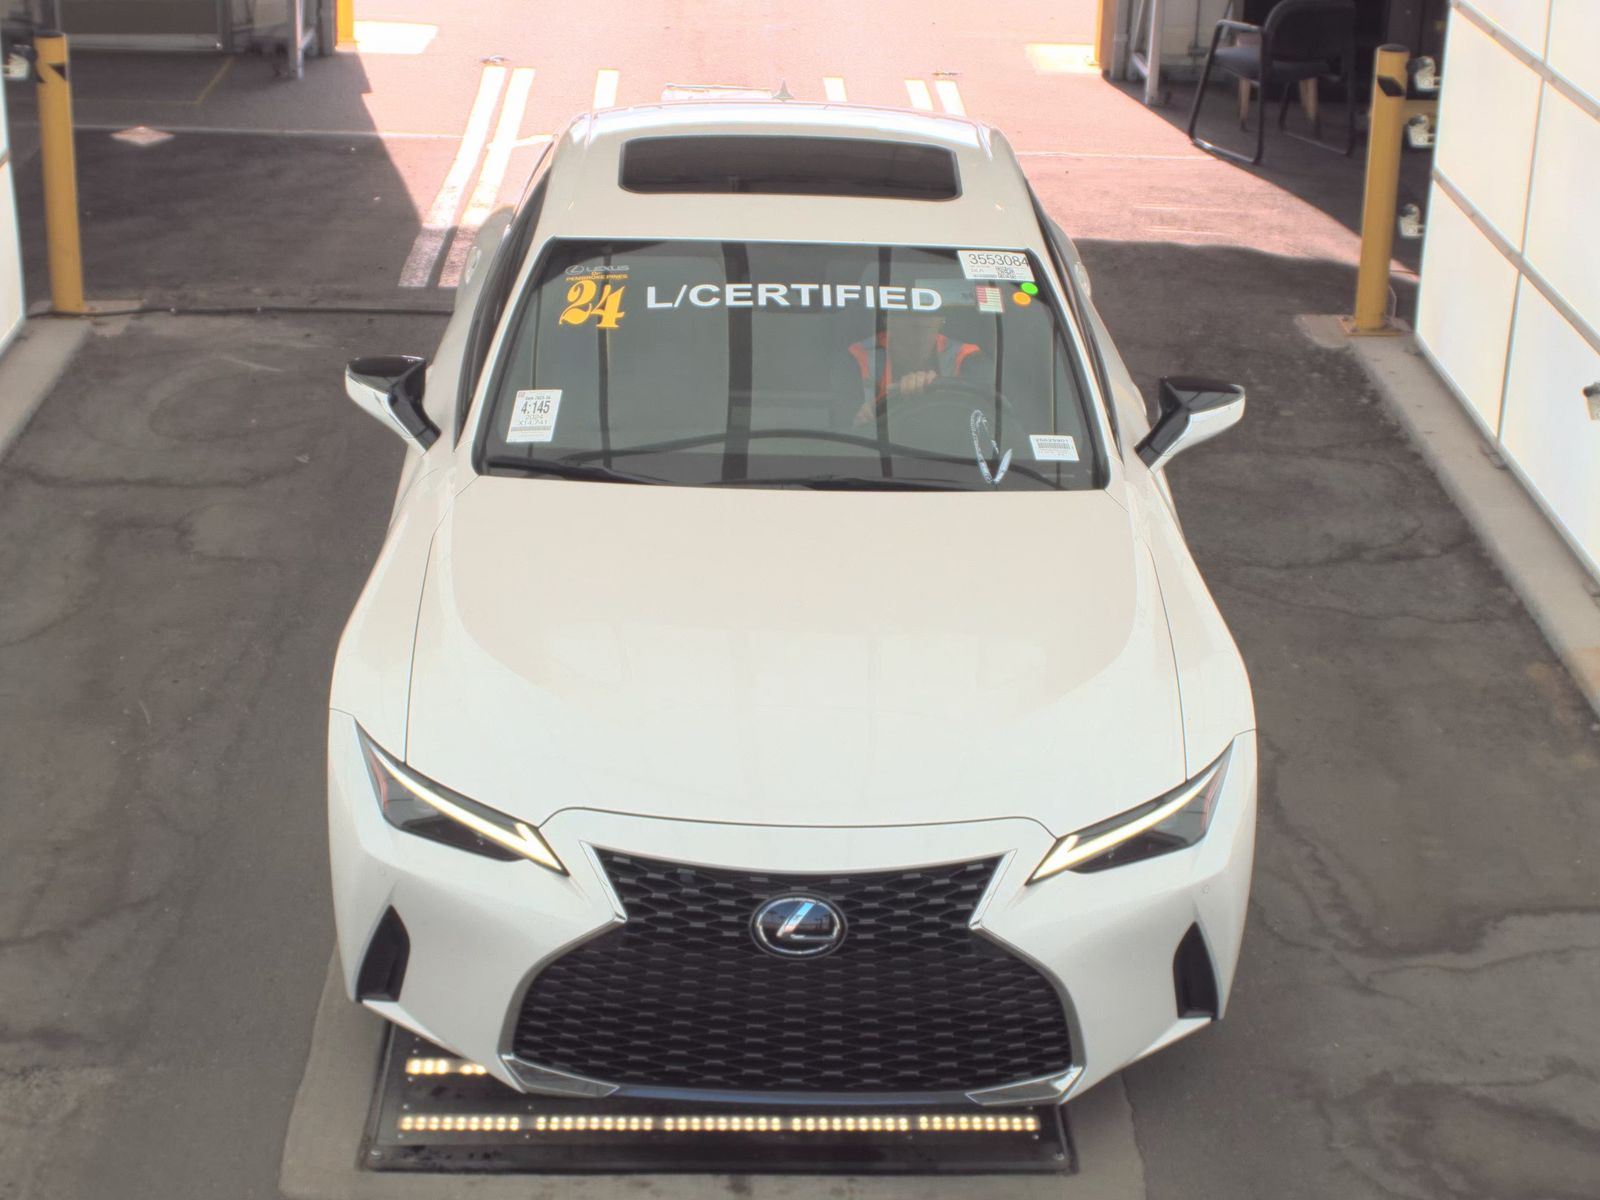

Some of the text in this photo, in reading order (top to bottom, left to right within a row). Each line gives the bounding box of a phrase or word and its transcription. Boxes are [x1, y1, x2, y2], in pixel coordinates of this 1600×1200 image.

[968, 253, 1030, 267] 3553084
[559, 280, 625, 328] 24
[647, 283, 942, 310] L/CERTIFIED
[520, 400, 551, 414] 4:145
